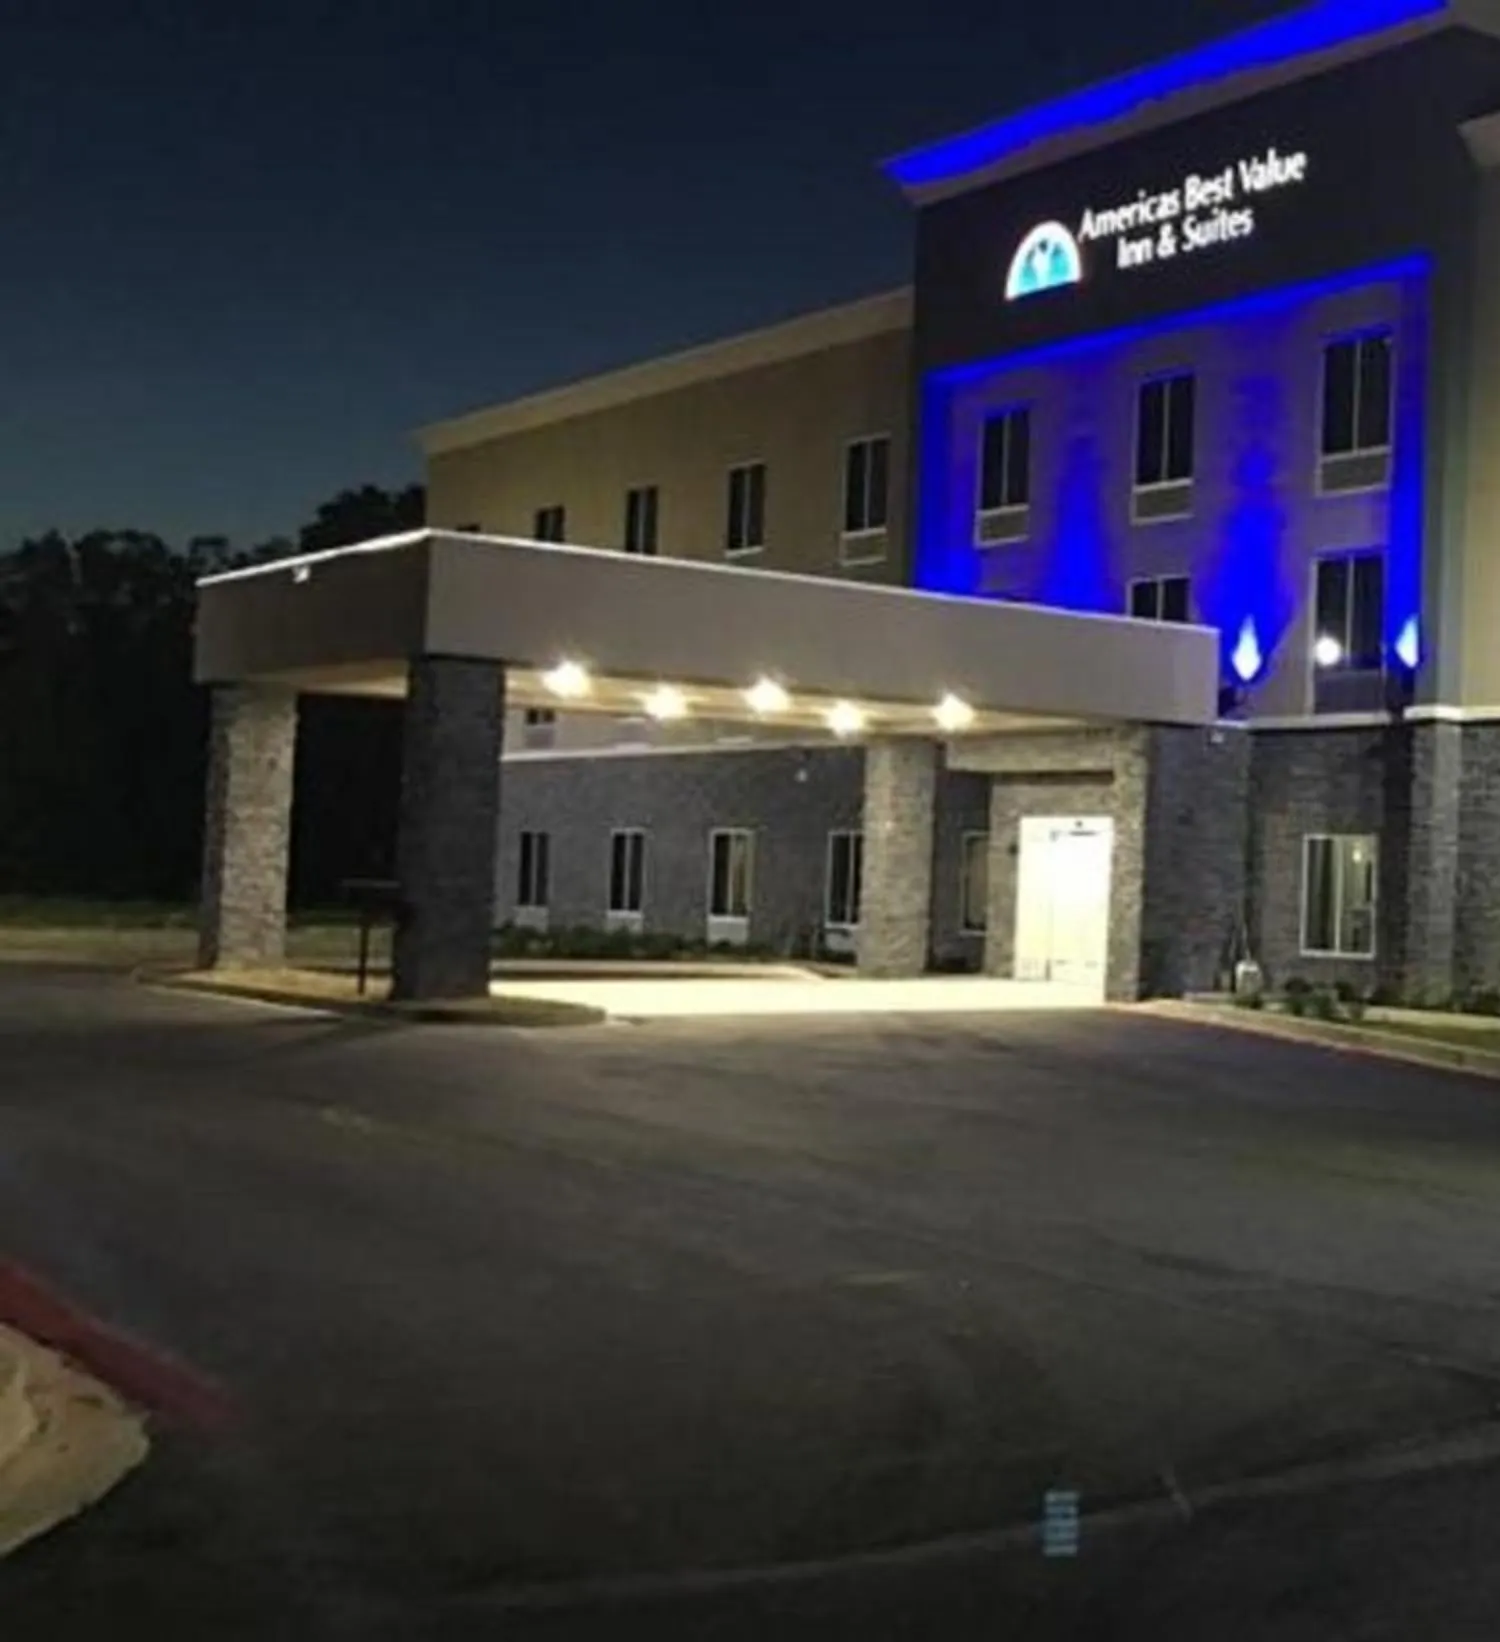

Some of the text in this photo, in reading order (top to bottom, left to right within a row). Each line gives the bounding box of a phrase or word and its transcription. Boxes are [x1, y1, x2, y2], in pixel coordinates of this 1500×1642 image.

[1077, 148, 1306, 242] Americas Best Value
[1117, 208, 1254, 268] Inn & Suites
